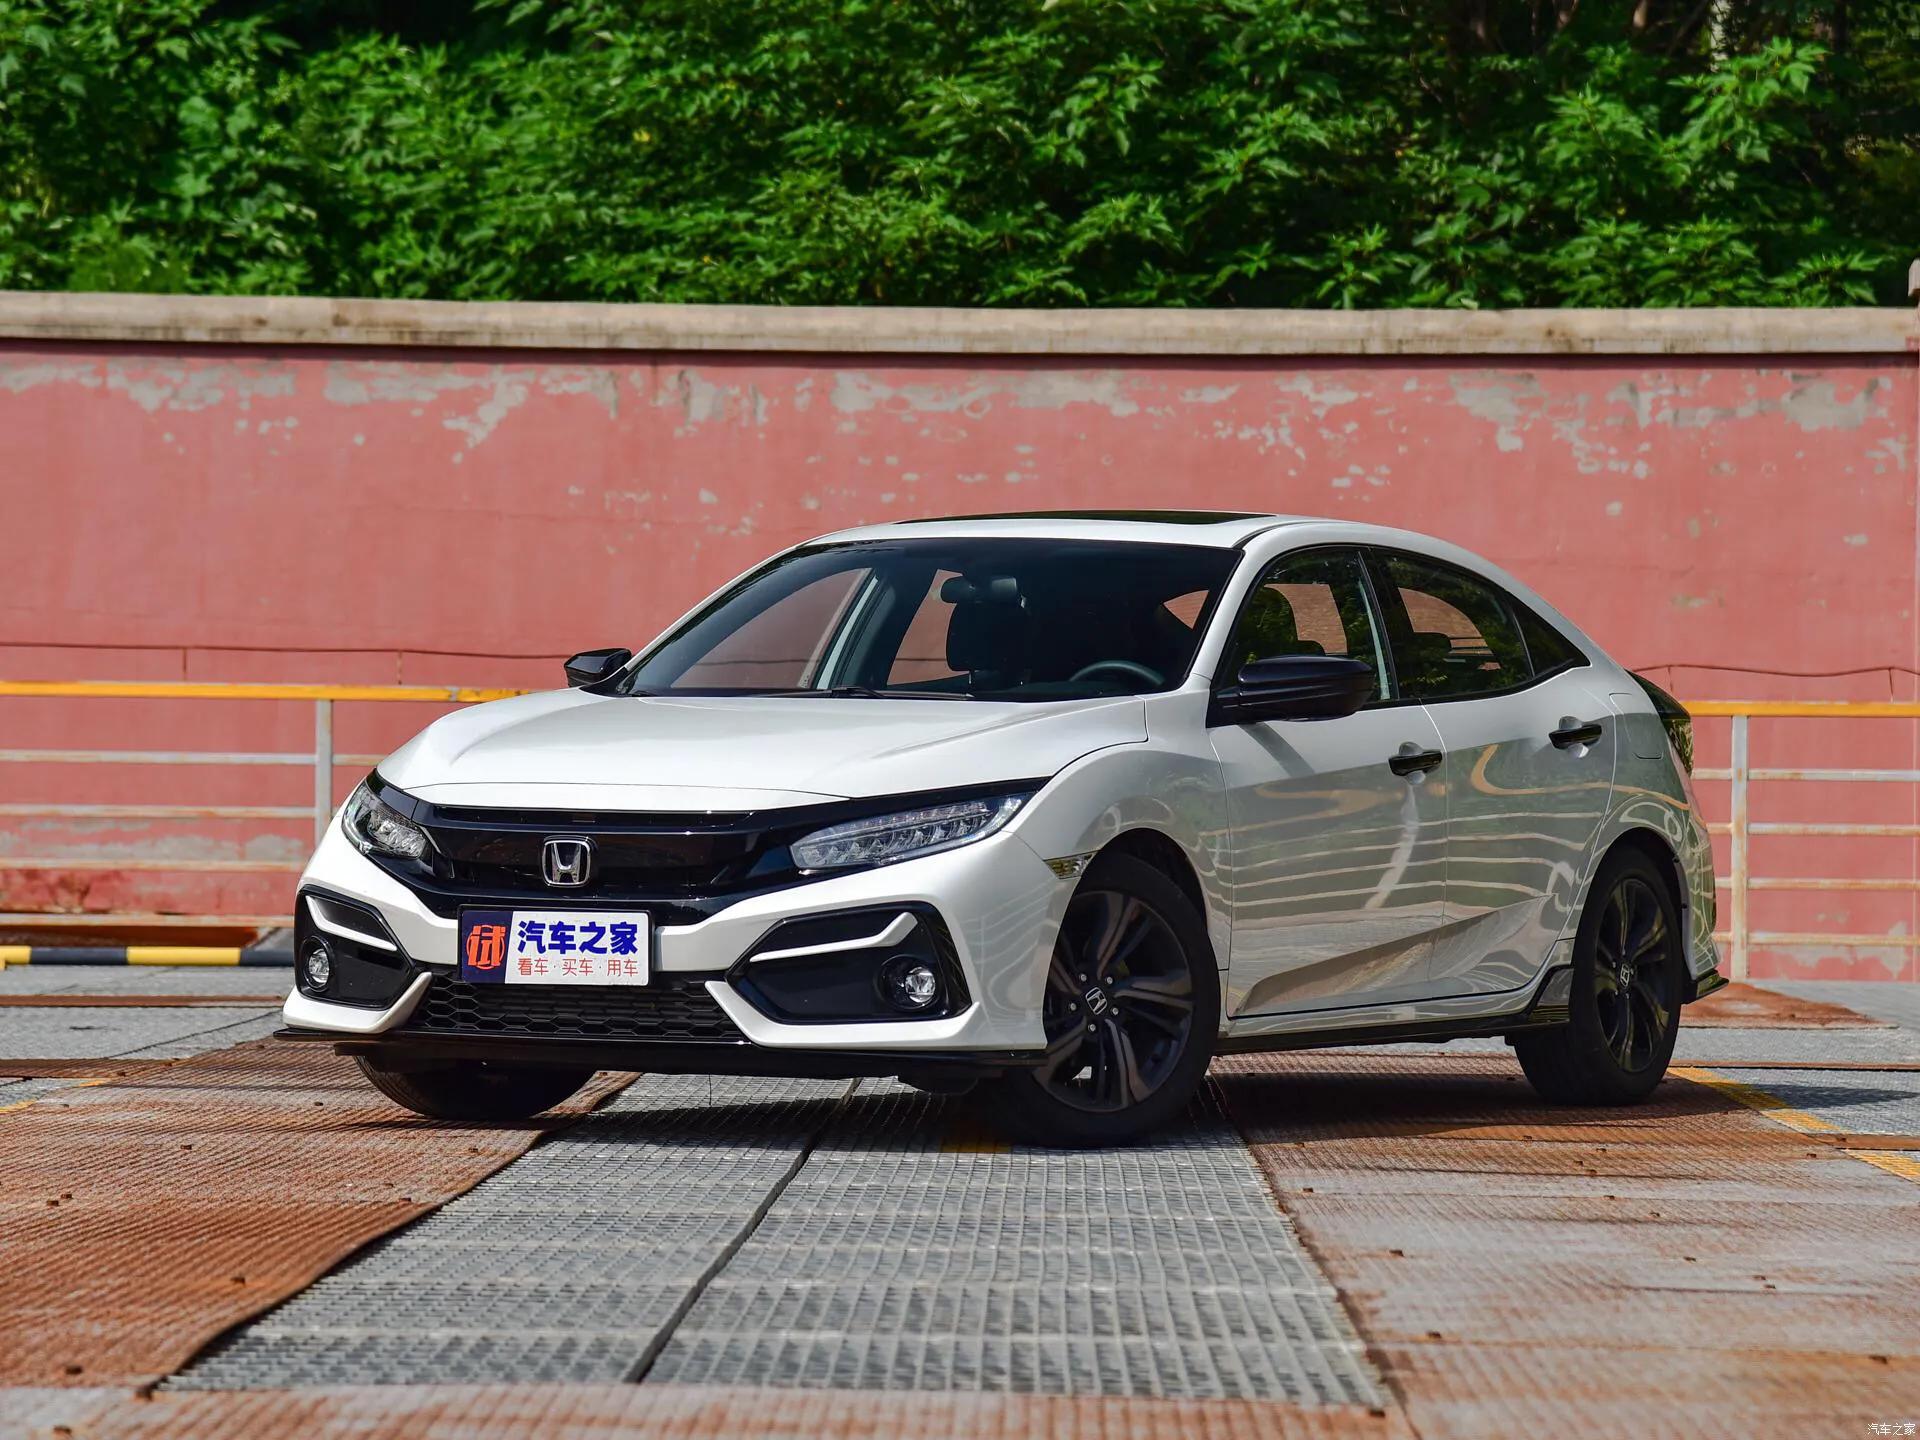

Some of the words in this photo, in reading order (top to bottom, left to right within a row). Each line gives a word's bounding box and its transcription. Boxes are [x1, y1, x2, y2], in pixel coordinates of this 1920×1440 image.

[466, 924, 508, 970] 试
[517, 920, 638, 956] 汽车之家
